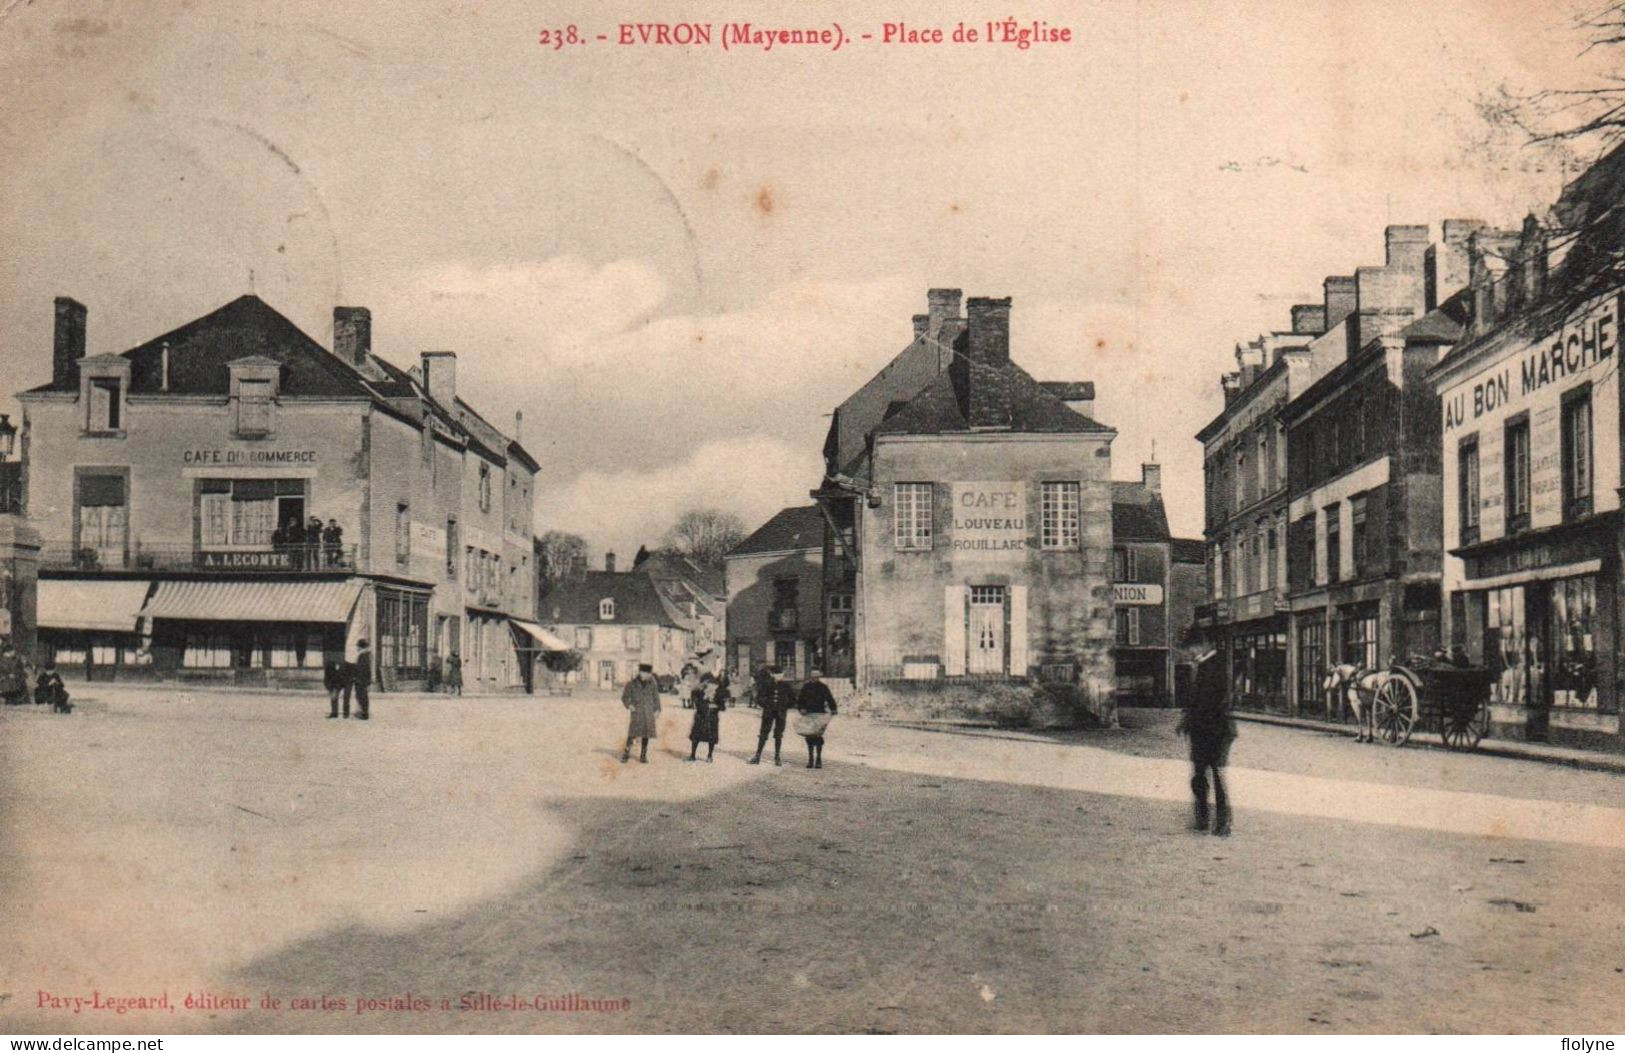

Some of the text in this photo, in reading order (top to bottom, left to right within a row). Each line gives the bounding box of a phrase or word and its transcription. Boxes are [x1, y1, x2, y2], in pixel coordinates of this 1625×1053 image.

[1445, 305, 1614, 433] AU BON MARCHÉ
[250, 450, 317, 463] COMMERCE
[954, 518, 1024, 530] LOUVEAU
[953, 539, 1025, 551] ROUILLARD
[223, 553, 290, 567] LECOMTE
[1113, 586, 1147, 601] NION
